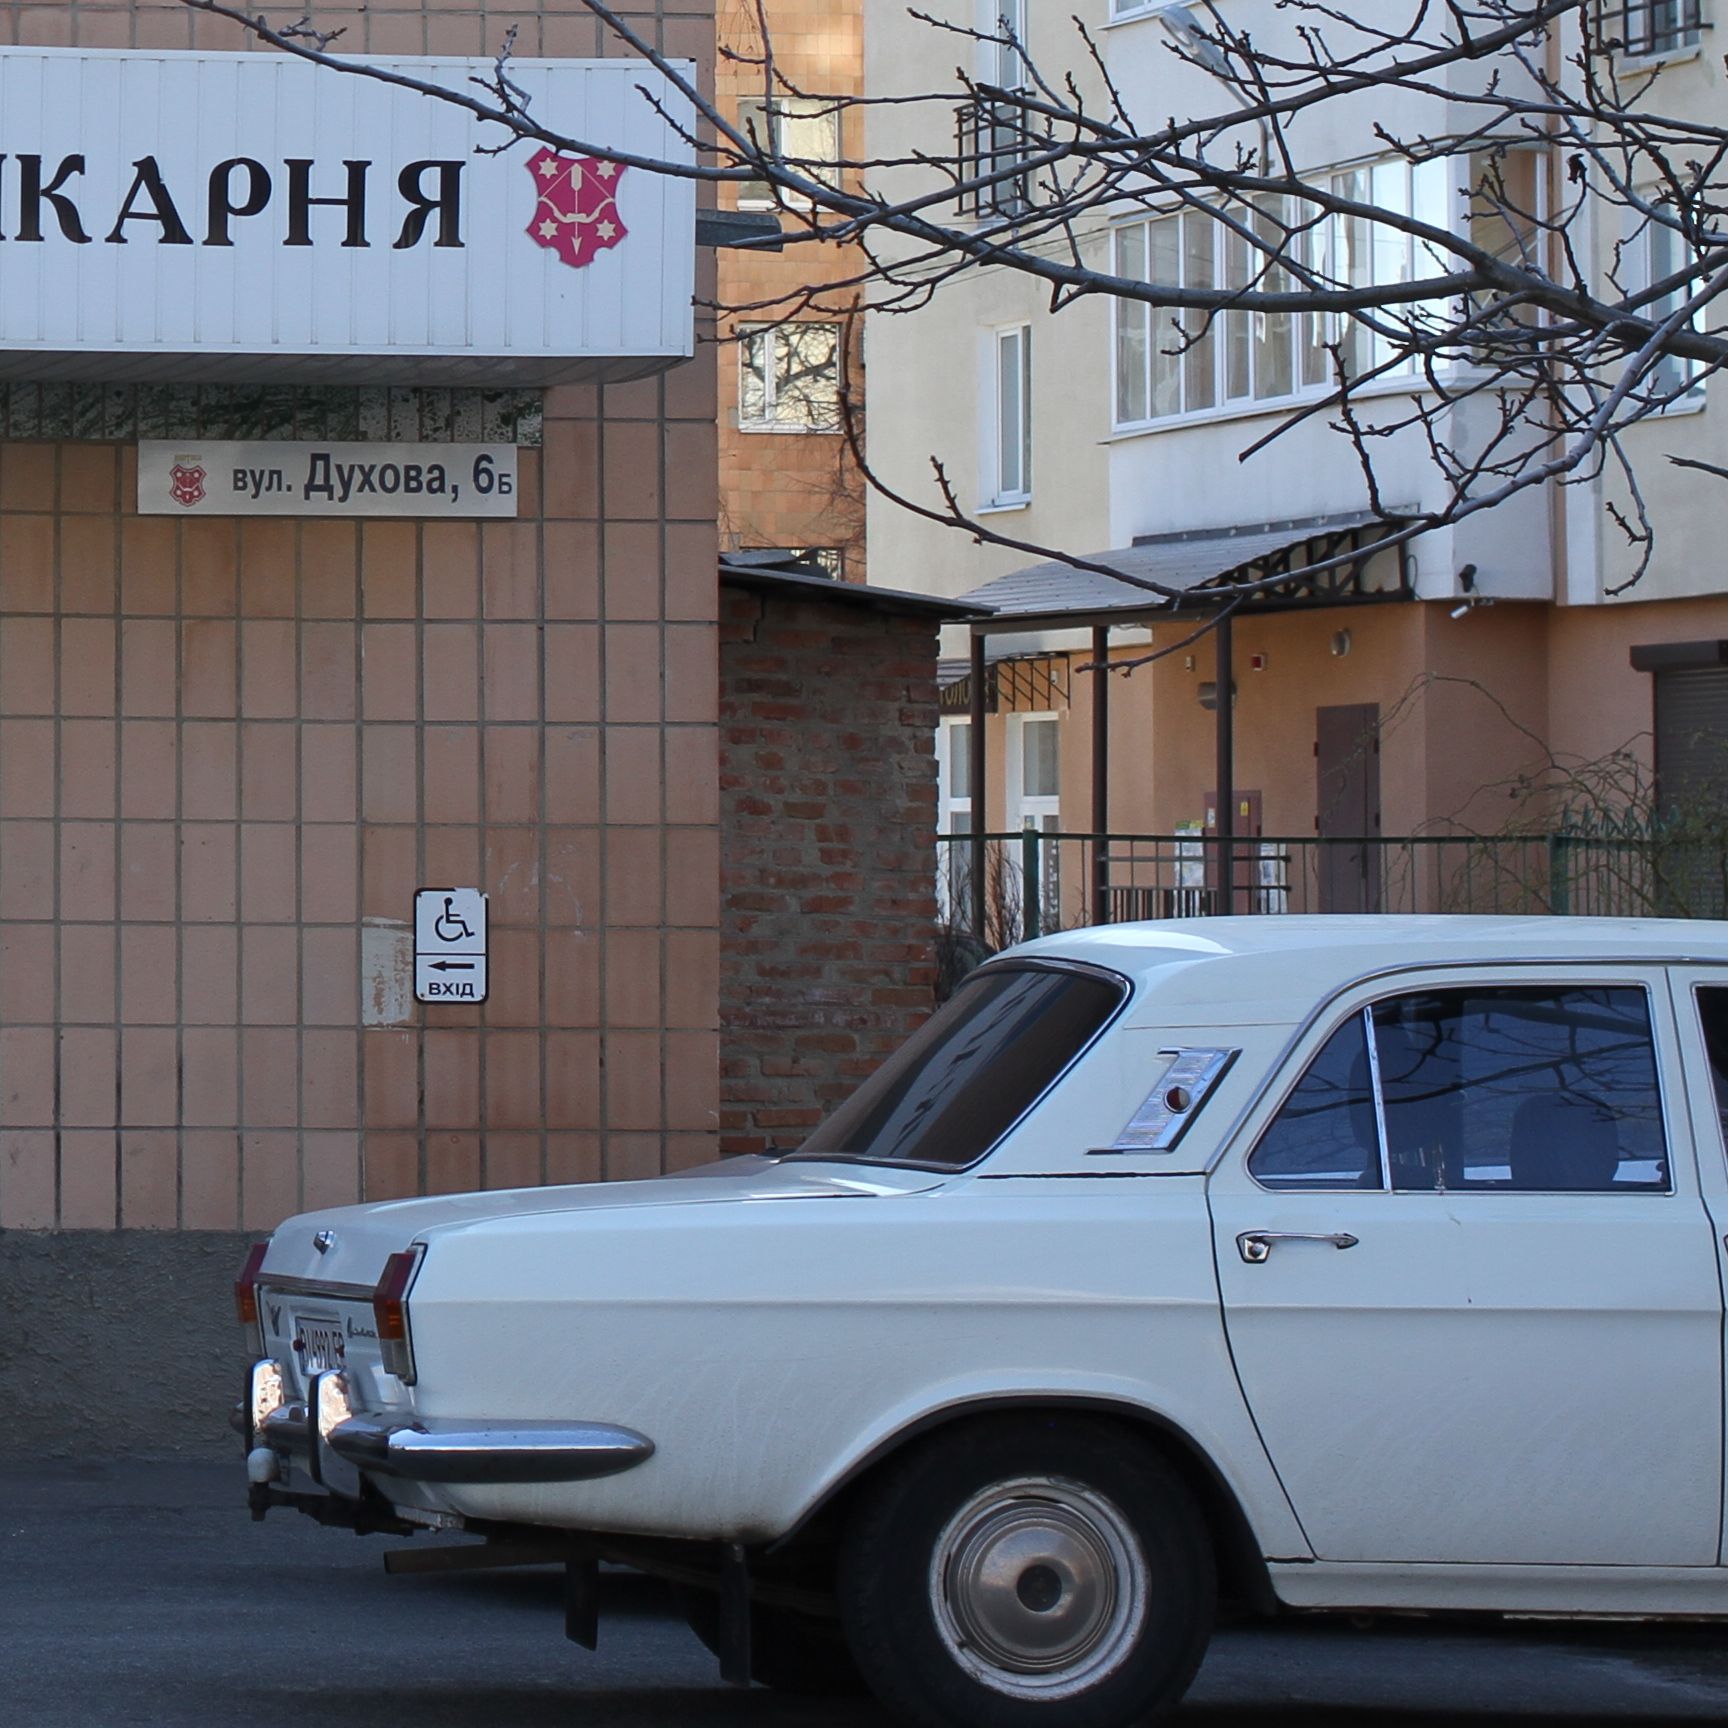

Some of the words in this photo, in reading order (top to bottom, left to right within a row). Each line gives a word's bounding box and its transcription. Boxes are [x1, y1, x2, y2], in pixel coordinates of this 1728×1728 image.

[232, 467, 293, 499] вул.
[304, 452, 459, 502] Духова,
[472, 453, 513, 494] 6Б
[428, 982, 475, 998] ВХІД
